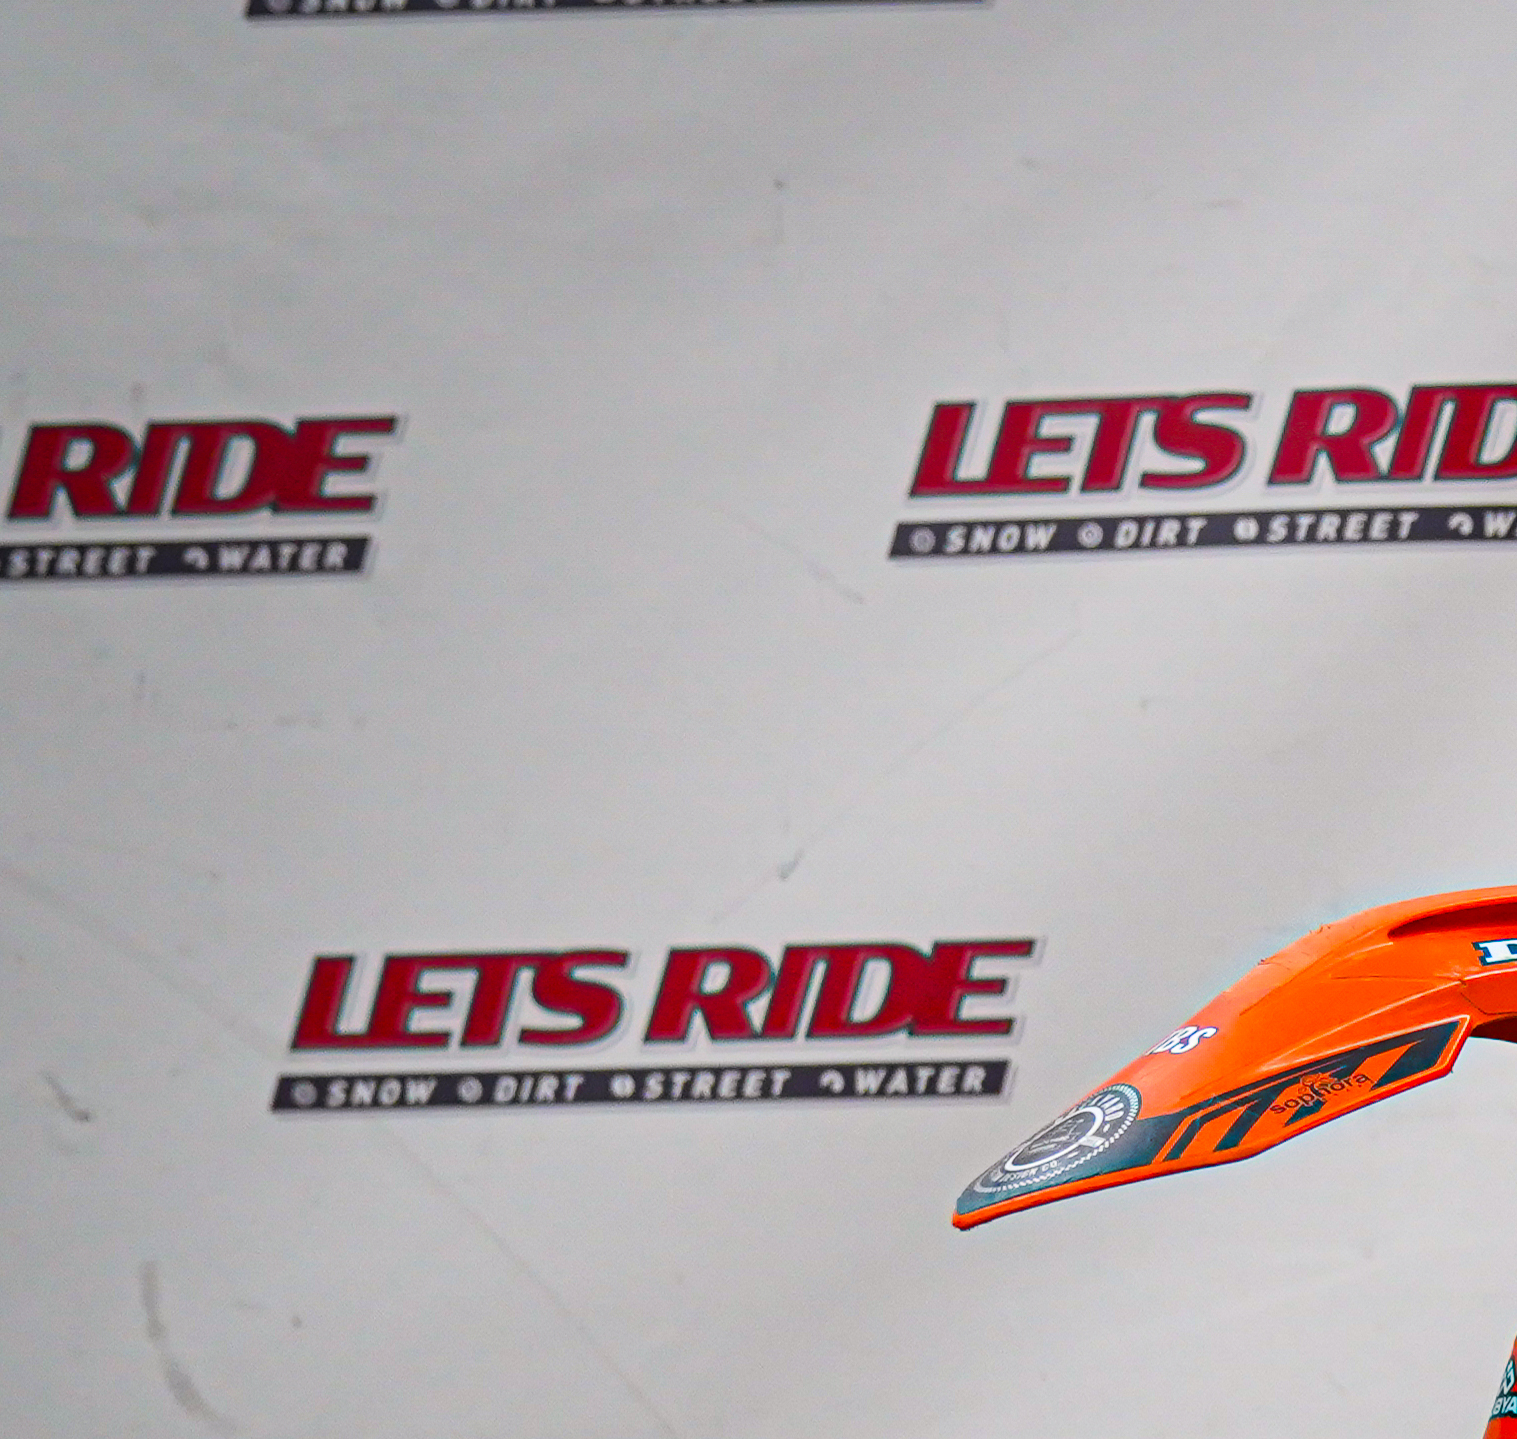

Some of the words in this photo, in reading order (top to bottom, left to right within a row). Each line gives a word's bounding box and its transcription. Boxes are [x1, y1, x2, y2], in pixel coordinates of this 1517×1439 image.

[6, 414, 398, 520] RIDE
[909, 394, 1252, 498] LETS
[8, 547, 155, 577] STREET
[217, 541, 348, 571] WATER
[944, 524, 1058, 552] SNOW
[1113, 519, 1207, 548] DIRT
[1267, 513, 1420, 543] STREET
[290, 950, 629, 1050] LETS
[643, 940, 1036, 1043] RIDE
[325, 1078, 438, 1108] SNOW
[492, 1074, 585, 1103] DIRT
[643, 1070, 792, 1101] STREET
[853, 1068, 986, 1096] WATER
